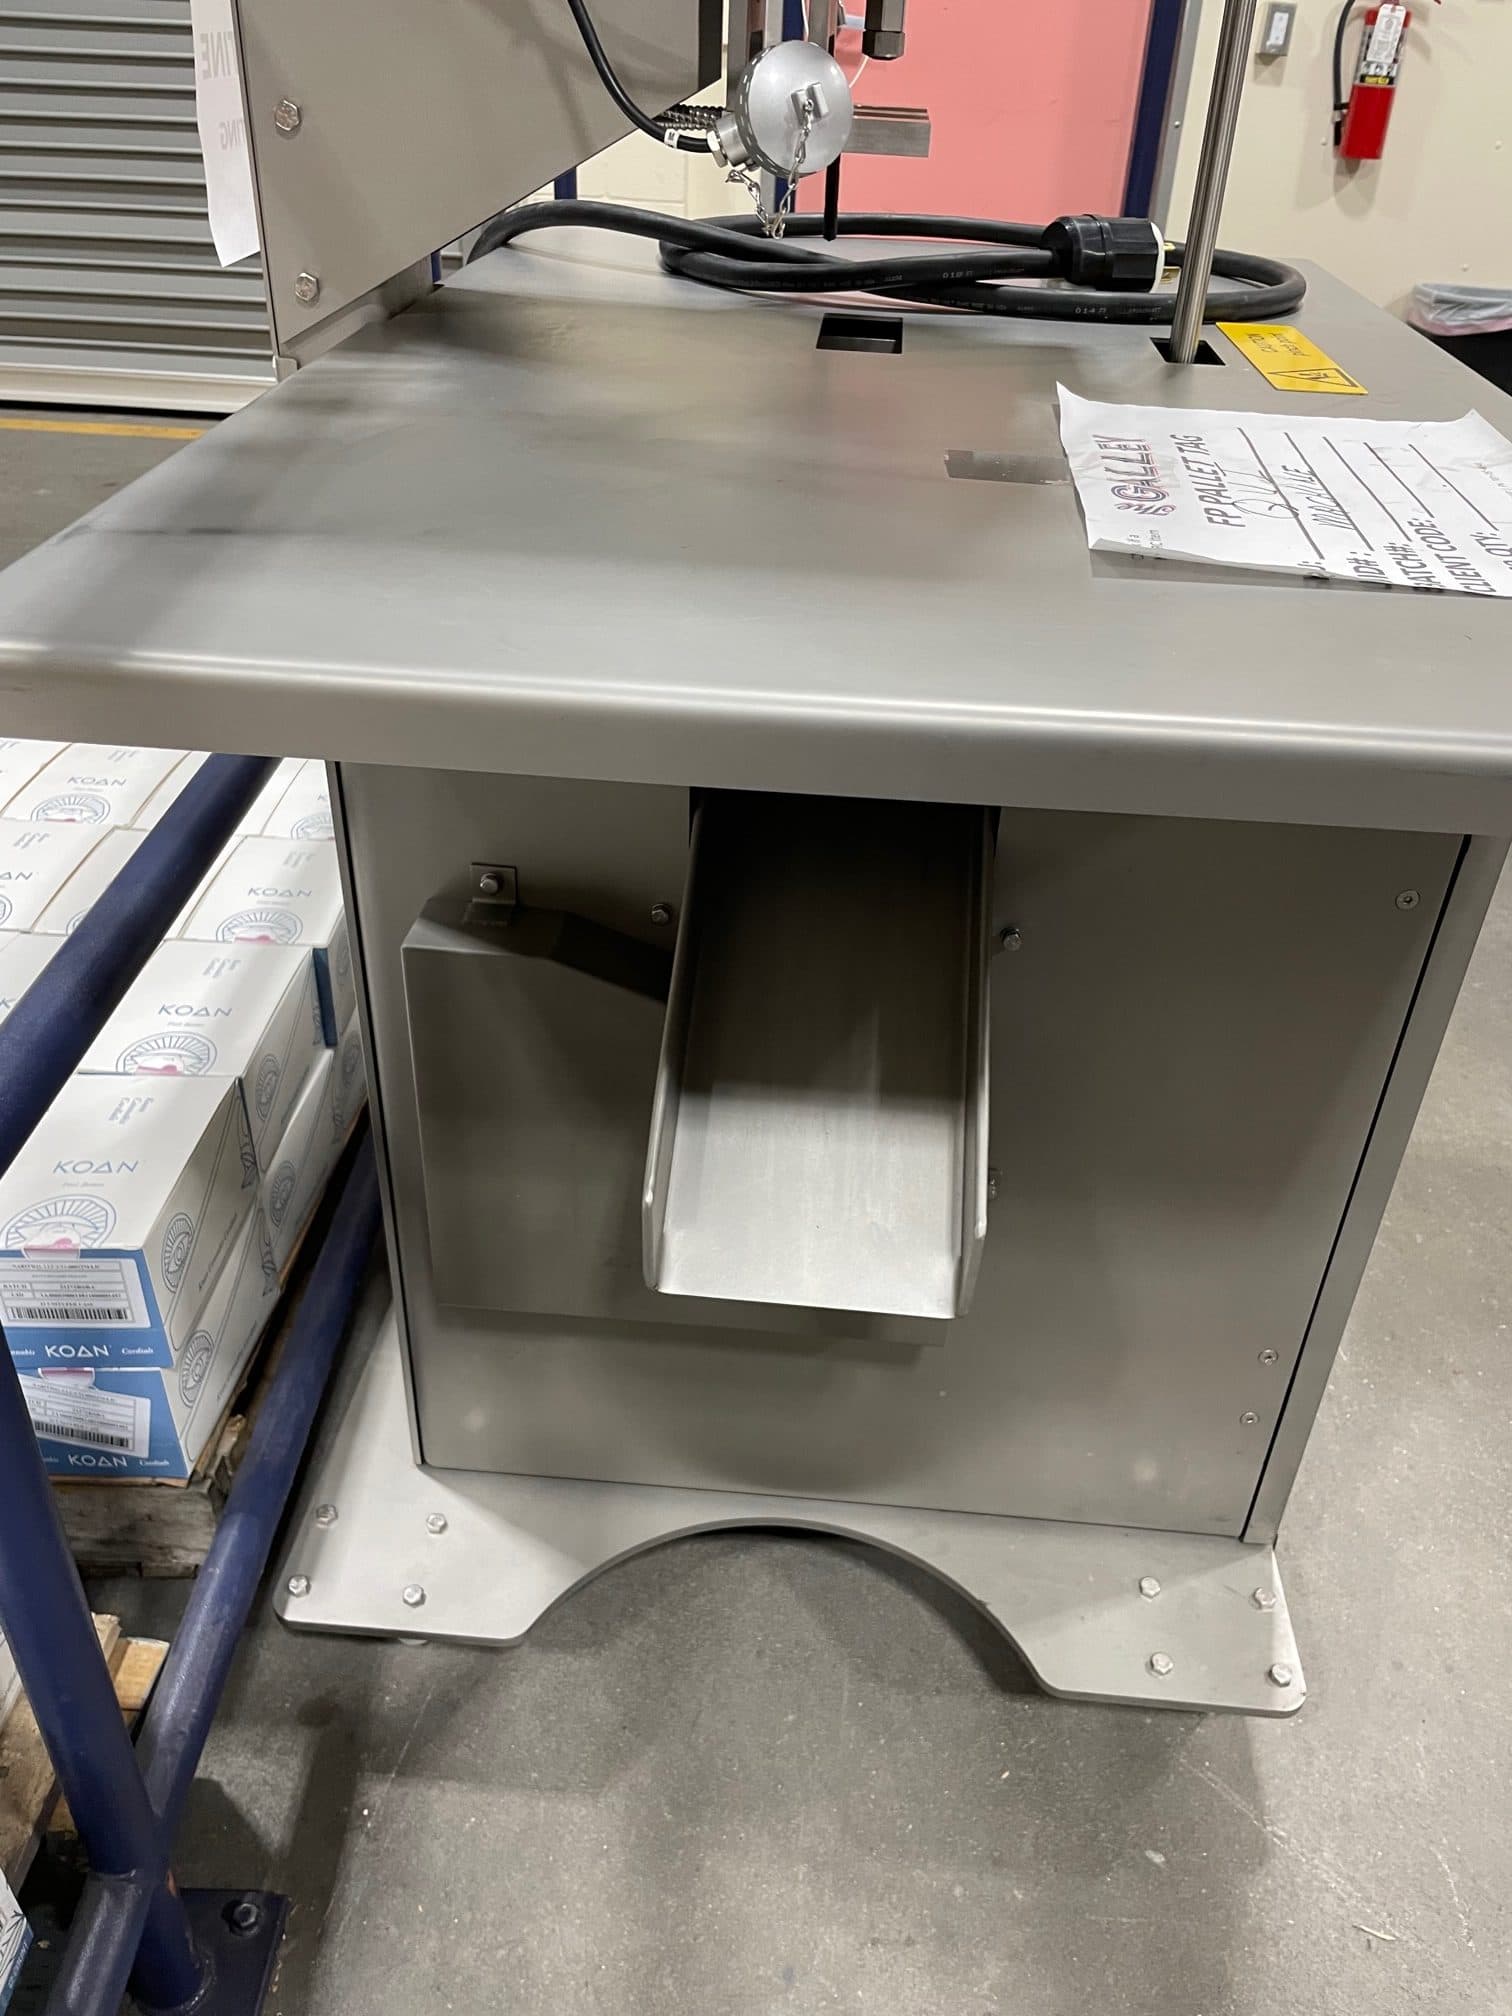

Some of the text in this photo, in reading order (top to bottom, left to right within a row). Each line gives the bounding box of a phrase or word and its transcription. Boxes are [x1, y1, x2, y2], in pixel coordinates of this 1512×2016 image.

[1092, 434, 1169, 502] GALLEY
[1170, 434, 1246, 528] FP PALLET TAG
[1406, 518, 1458, 552] CODE:
[1434, 553, 1497, 593] CLIENT
[158, 1004, 233, 1017] KOAN
[53, 1160, 139, 1175] KOAN
[44, 1344, 111, 1358] KOAN
[67, 1454, 129, 1468] KOAN
